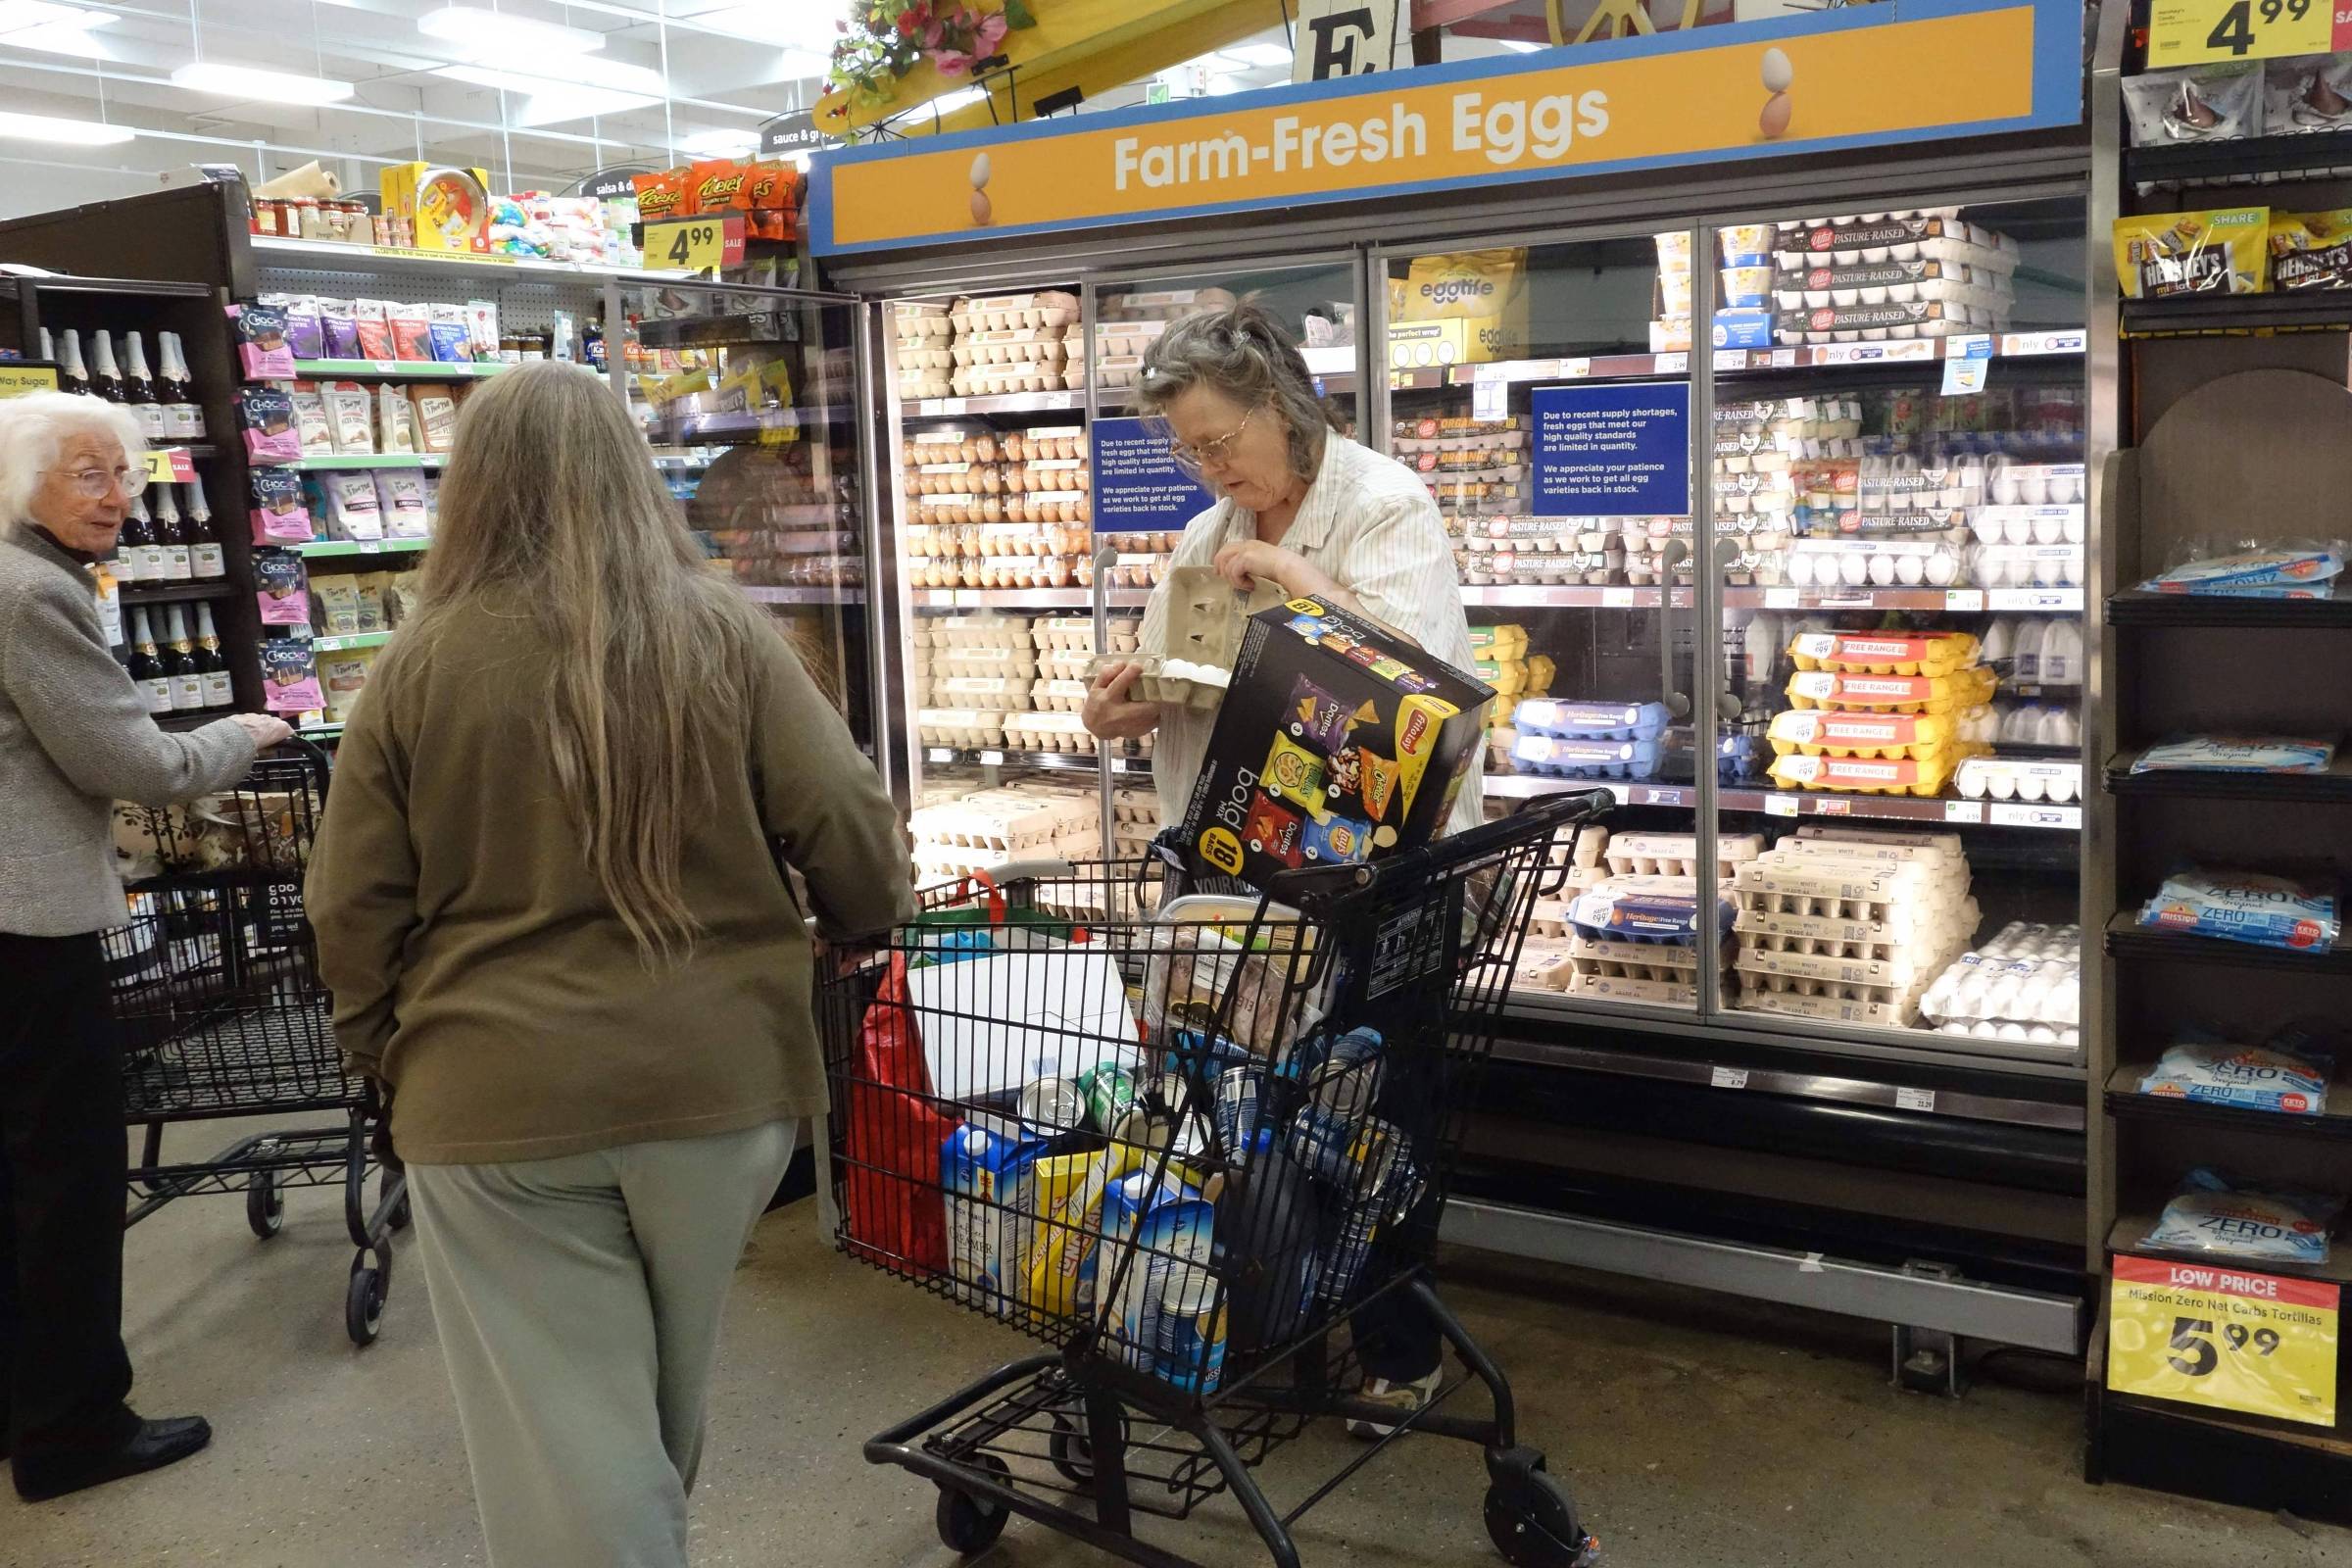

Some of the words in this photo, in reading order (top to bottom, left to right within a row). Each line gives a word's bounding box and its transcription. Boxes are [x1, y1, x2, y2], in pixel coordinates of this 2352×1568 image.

[2336, 11, 2352, 24] SA
[1309, 7, 1376, 80] E
[773, 132, 799, 145] sauce
[801, 129, 808, 141] &
[1114, 103, 1427, 190] Farm-Fresh
[1452, 89, 1609, 165] Eggs
[596, 183, 617, 195] salsa
[617, 182, 627, 193] &
[2213, 213, 2254, 224] SHARE
[1835, 229, 1905, 243] PASTURE-RAISED
[1833, 270, 1903, 282] PASTURE-RAISED
[2146, 253, 2221, 287] HEHEY'S
[1835, 312, 1905, 323] PASTURE-RAISED
[1397, 328, 1421, 339] perfect
[20, 376, 49, 388] Sugar
[1633, 408, 1678, 417] shortages,
[1564, 432, 1592, 441] quality
[1600, 442, 1638, 451] quantity.
[1442, 451, 1487, 463] ORGANIC
[1560, 465, 1603, 474] appreciate
[1628, 463, 1664, 472] patience
[1603, 475, 1617, 484] get
[1633, 474, 1648, 483] egg
[1858, 476, 1925, 488] PASTURE-RAISED
[1115, 486, 1151, 495] appreciate
[1168, 484, 1198, 493] patience
[1441, 484, 1487, 496] ORGANIC
[1509, 521, 1566, 531] PASTURE-RAISED
[1862, 516, 1930, 526] PASTURE-RAISED
[1514, 558, 1572, 568] PASTURE-RAISED
[1321, 613, 1366, 640] bold
[1319, 703, 1339, 737] Doritos
[1372, 768, 1388, 802] Cheetos
[1223, 766, 1260, 831] bold
[1215, 800, 1227, 818] MIX
[1205, 832, 1215, 857] BAGS
[1280, 821, 1298, 857] Doritos
[1337, 827, 1350, 856] Lay's
[1213, 839, 1237, 868] 18
[1626, 912, 1658, 923] Heritage
[2160, 911, 2197, 925] mission
[2203, 906, 2245, 923] ZERO
[2190, 1084, 2232, 1098] ZERO
[2199, 1215, 2281, 1239] ZERO
[2170, 1267, 2214, 1287] LOW
[2220, 1274, 2278, 1298] PRICE
[2129, 1289, 2172, 1304] Mission
[2176, 1296, 2203, 1308] Zero
[2208, 1299, 2229, 1311] Net
[2233, 1303, 2268, 1318] Carbs
[2272, 1309, 2323, 1326] Tortillas
